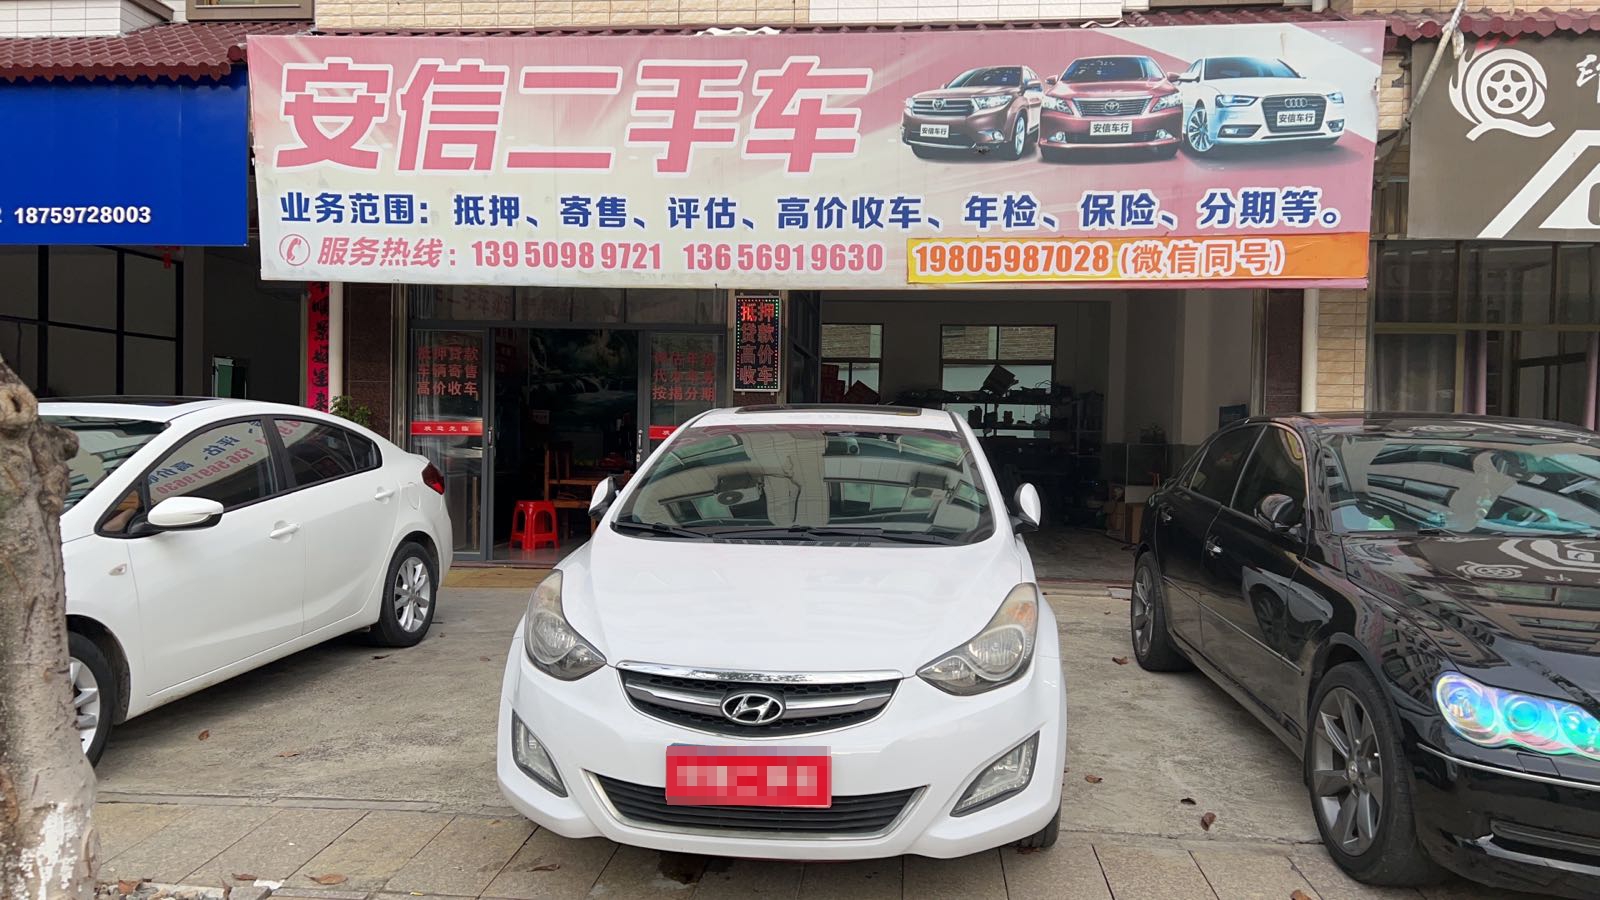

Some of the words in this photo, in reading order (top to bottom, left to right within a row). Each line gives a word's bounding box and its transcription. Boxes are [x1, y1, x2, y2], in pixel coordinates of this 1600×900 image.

[275, 60, 871, 175] 安信二手车
[1093, 122, 1130, 133] 安信车行
[1278, 112, 1314, 123] 安信车行
[921, 127, 947, 135] 安信车行
[14, 206, 151, 224] 18759728003
[915, 243, 1110, 273] 19805987028
[740, 302, 775, 322] 抵押
[740, 323, 775, 343] 贷款
[739, 343, 774, 365] 高价
[739, 365, 774, 385] 收车
[416, 381, 478, 396] 高价收车
